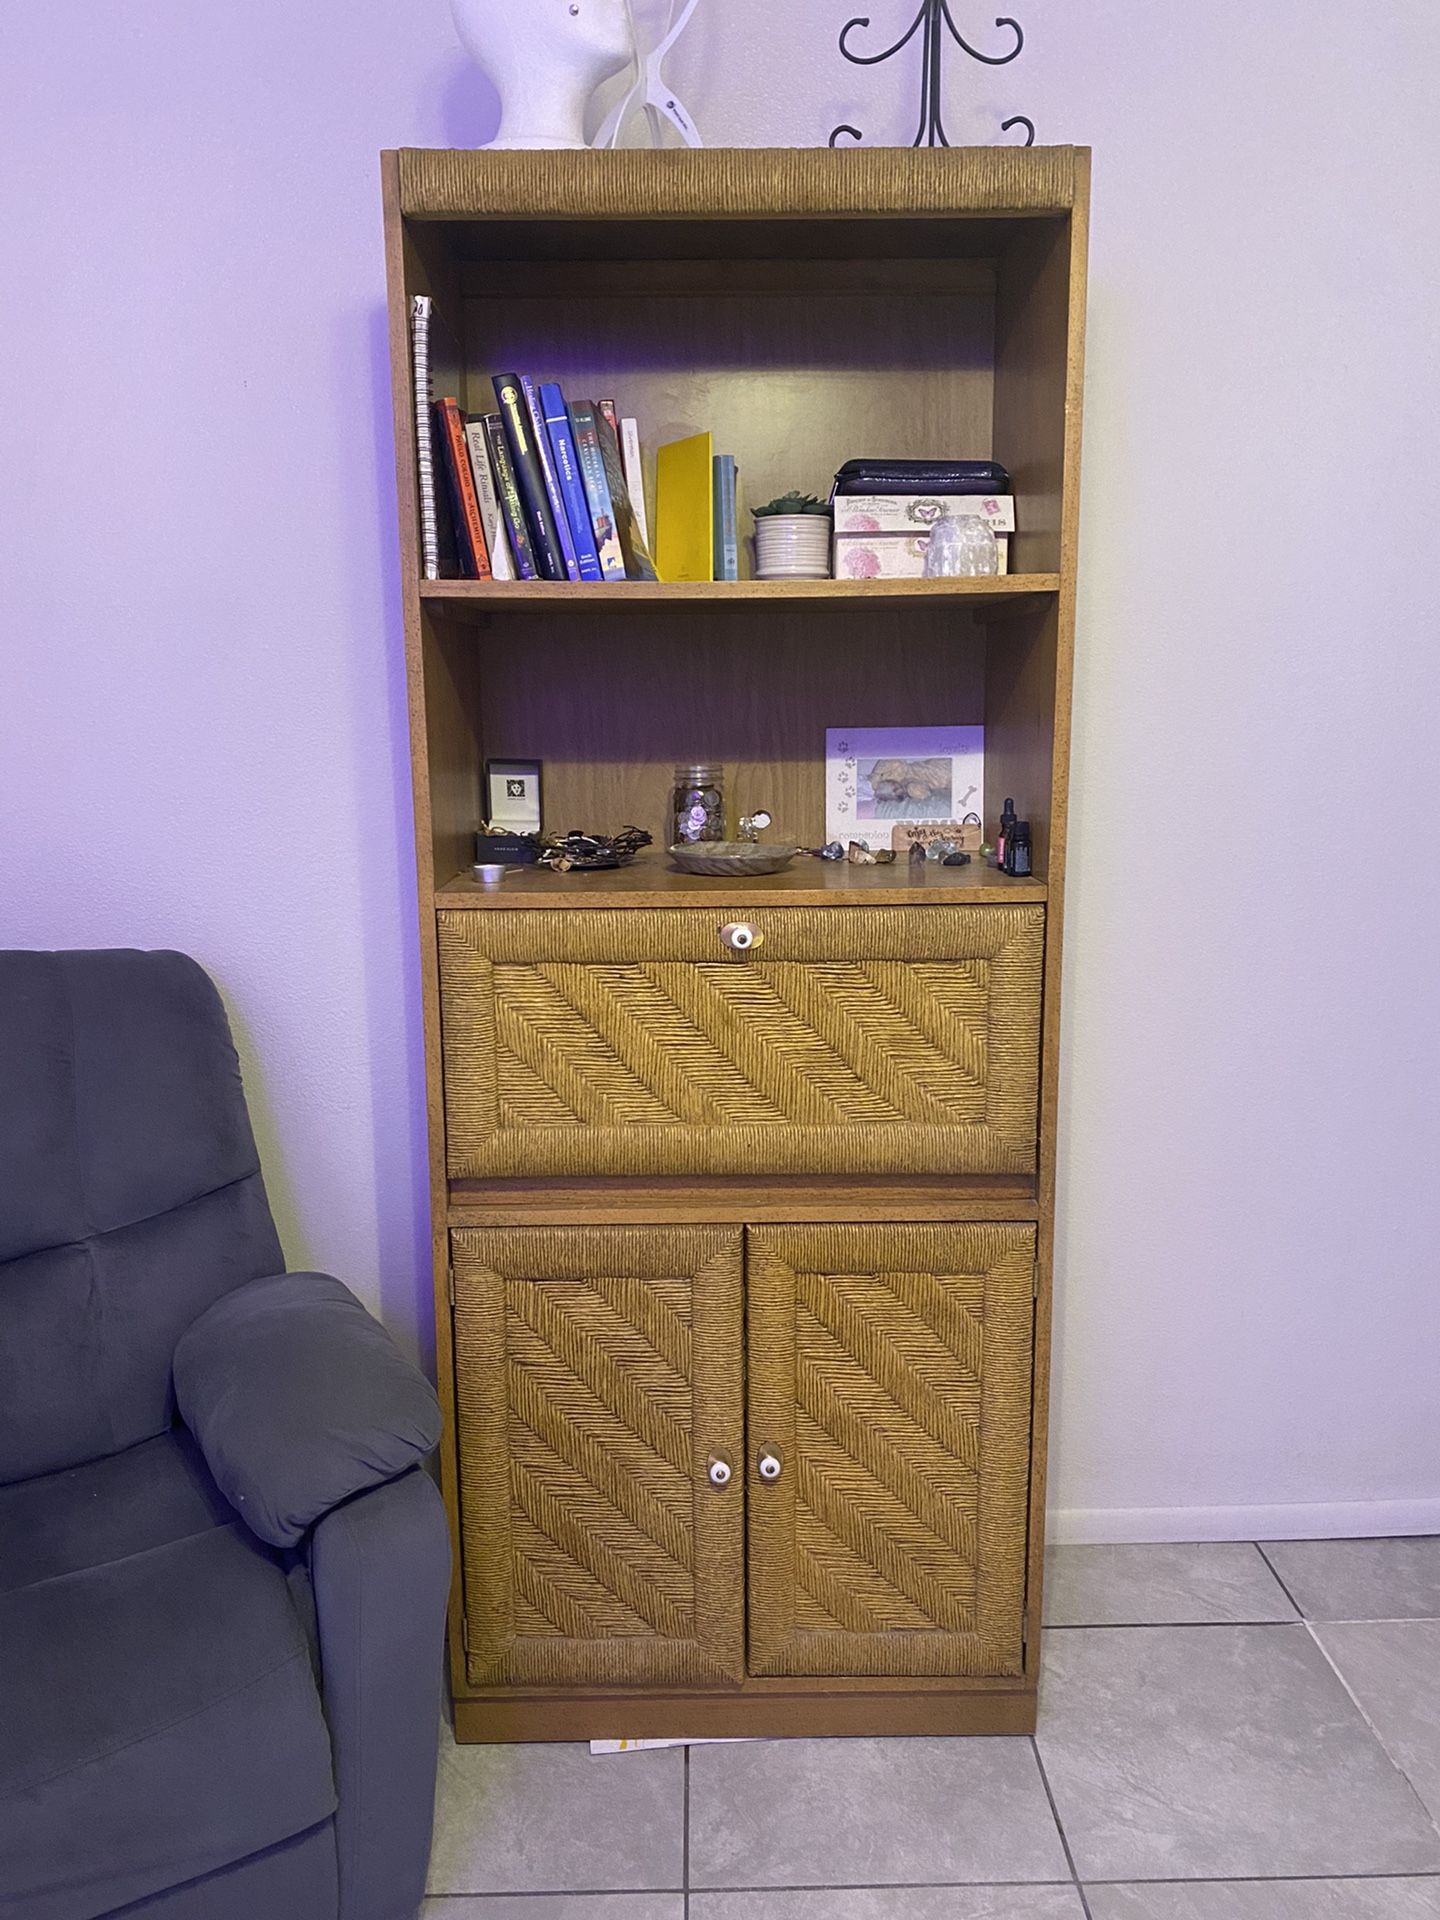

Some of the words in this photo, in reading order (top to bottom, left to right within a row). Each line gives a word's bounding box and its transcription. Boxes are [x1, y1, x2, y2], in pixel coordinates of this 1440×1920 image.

[455, 435, 464, 458] PAULO
[471, 431, 484, 452] Real
[473, 454, 488, 472] Life
[557, 438, 574, 481] Narcotics
[459, 459, 470, 487] COELHO
[479, 473, 493, 504] Rituals
[497, 445, 512, 482] Language
[506, 481, 514, 490] of
[513, 517, 522, 529] Go
[597, 480, 605, 494] THE
[468, 502, 482, 544] ALCHEMIST
[838, 829, 890, 841] companion
